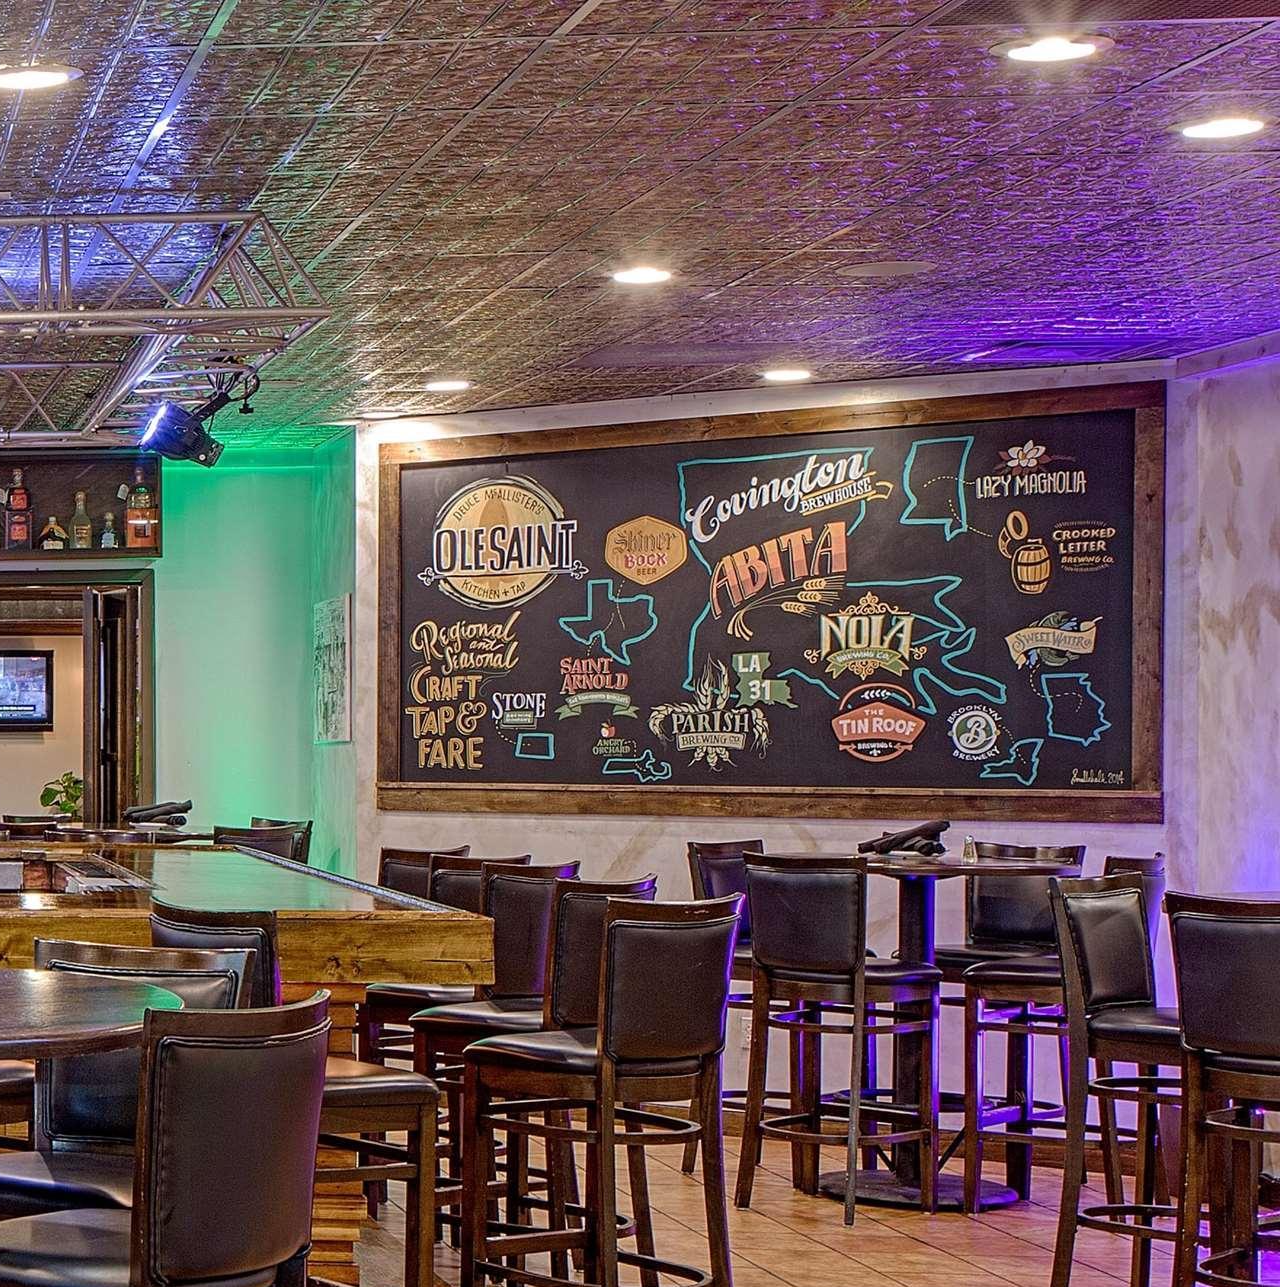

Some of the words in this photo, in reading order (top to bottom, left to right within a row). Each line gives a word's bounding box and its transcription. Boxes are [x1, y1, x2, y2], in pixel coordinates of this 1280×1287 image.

[799, 476, 873, 514] BREWHOUSE
[975, 474, 1012, 499] LAZY
[1014, 470, 1088, 497] MAGNOLIA
[453, 494, 480, 521] DEUCE
[685, 453, 865, 543] Covington
[1052, 527, 1116, 541] CROOKED
[1058, 540, 1107, 554] LETTER
[624, 552, 668, 569] BOCK
[1061, 555, 1102, 564] BREWING
[636, 568, 657, 576] BEER
[709, 521, 848, 620] ABITA
[461, 579, 500, 600] KITCHEN
[511, 582, 527, 596] TAP
[410, 610, 522, 664] Regional
[469, 639, 505, 651] and
[820, 614, 916, 662] NOLA
[441, 641, 520, 675] Seasonal
[560, 656, 614, 675] SAINT
[738, 654, 761, 673] LA
[410, 665, 483, 704] CRAFT
[559, 672, 629, 695] ARNOLD
[748, 680, 771, 701] 31
[491, 692, 547, 720] STONE
[863, 708, 885, 716] THE
[946, 704, 1003, 724] BROOKLYN
[405, 706, 455, 739] TAP
[456, 701, 488, 735] &
[671, 710, 750, 735] PARISH
[839, 718, 869, 736] TIN
[872, 717, 916, 736] ROOF
[592, 746, 631, 755] ORCHARD
[596, 739, 625, 747] ANGRY
[681, 736, 727, 746] BREWING
[418, 736, 485, 770] FARE
[952, 745, 1002, 761] BREWERY
